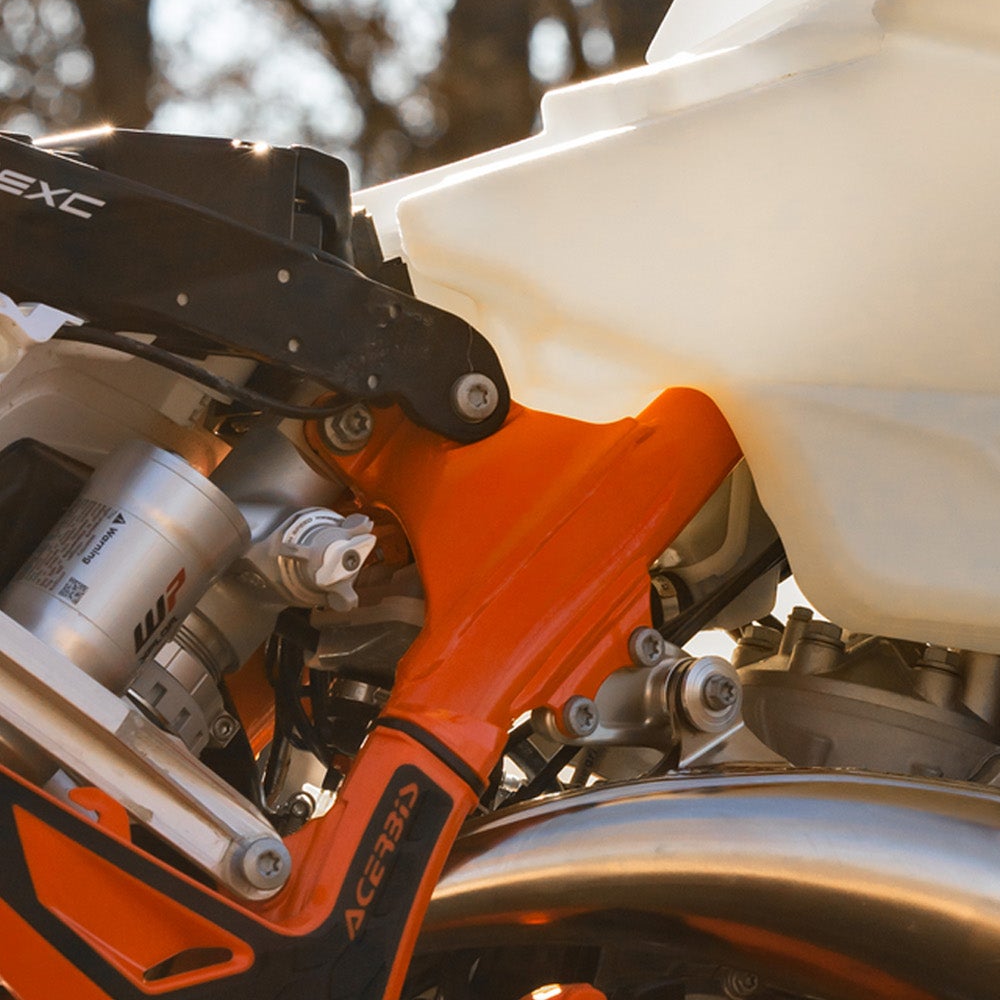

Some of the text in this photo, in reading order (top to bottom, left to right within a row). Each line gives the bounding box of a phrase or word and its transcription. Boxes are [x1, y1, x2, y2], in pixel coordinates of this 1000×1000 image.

[0, 168, 107, 220] EXC
[81, 526, 119, 566] Warning
[344, 782, 420, 941] ACERBIS
